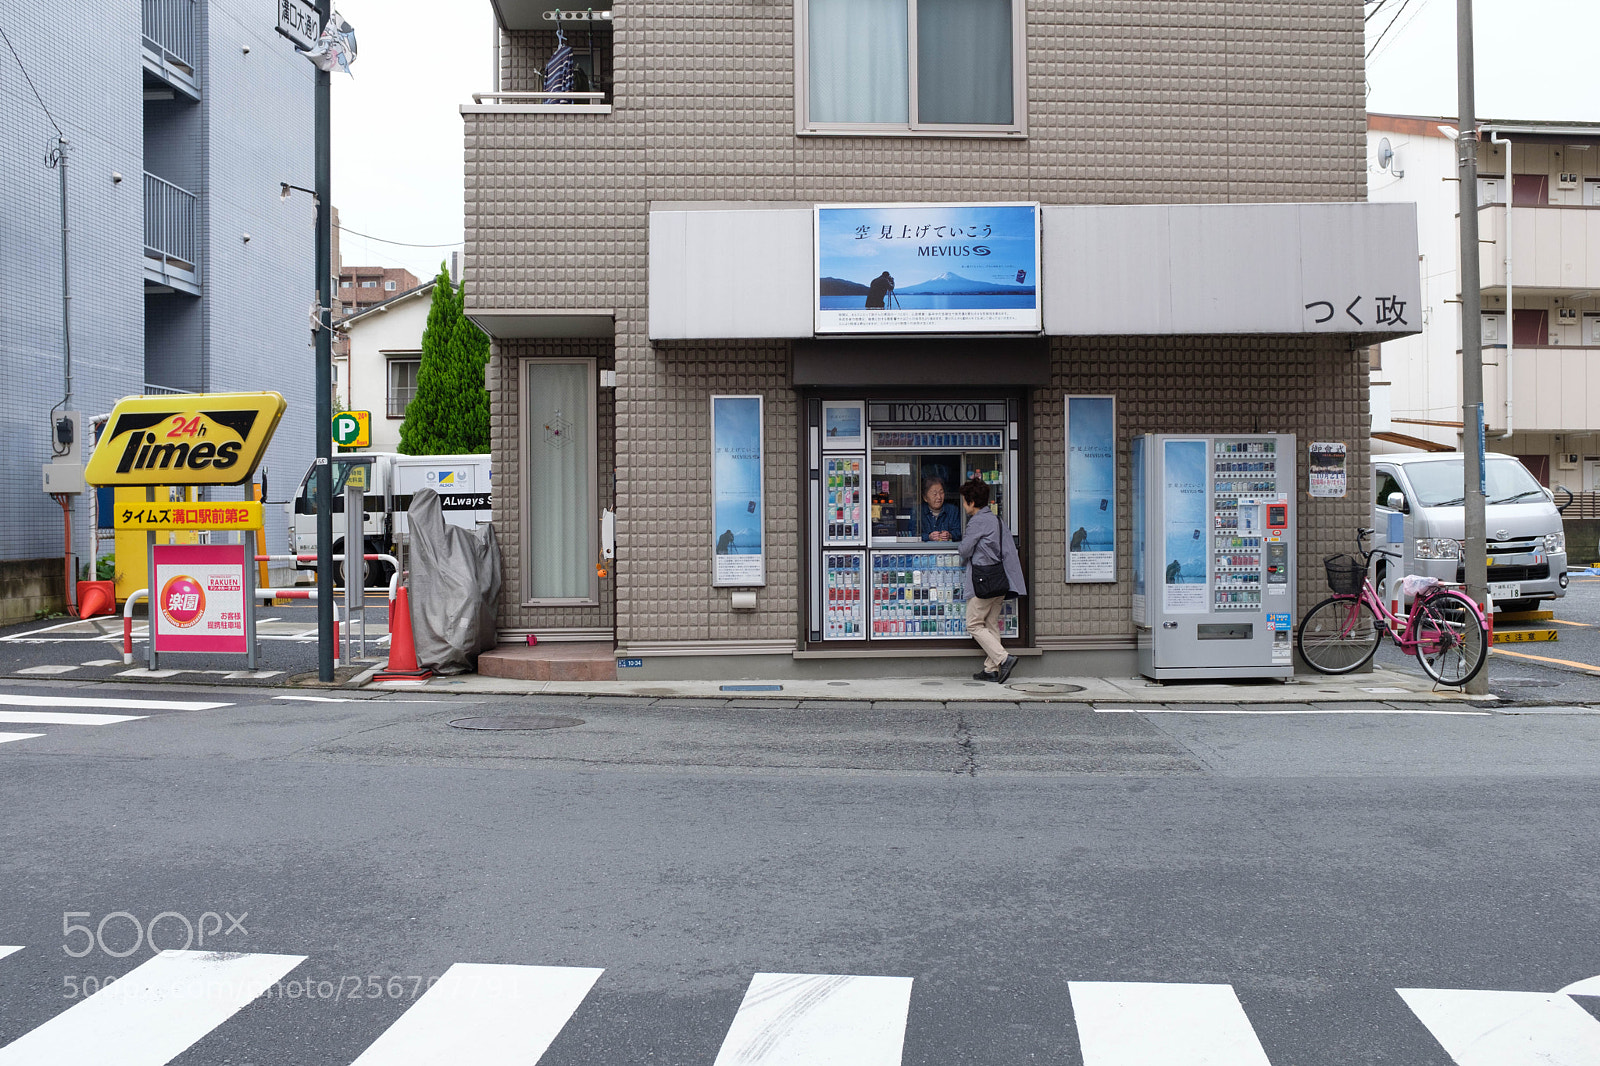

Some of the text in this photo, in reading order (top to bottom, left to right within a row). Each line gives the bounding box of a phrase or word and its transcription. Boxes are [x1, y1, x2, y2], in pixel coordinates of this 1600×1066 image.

[917, 245, 970, 257] MEVIUS
[1305, 295, 1408, 326] つく政
[896, 403, 978, 423] TOBACCO
[166, 415, 207, 438] 24h
[338, 418, 356, 441] P
[115, 429, 243, 474] Times
[443, 495, 485, 507] ALways
[122, 508, 249, 525] タイムズ溝口駅前第2
[210, 578, 239, 586] RAKUEN
[168, 592, 199, 612] 楽園
[220, 612, 242, 620] お客様
[1492, 632, 1536, 642] 高さ注意
